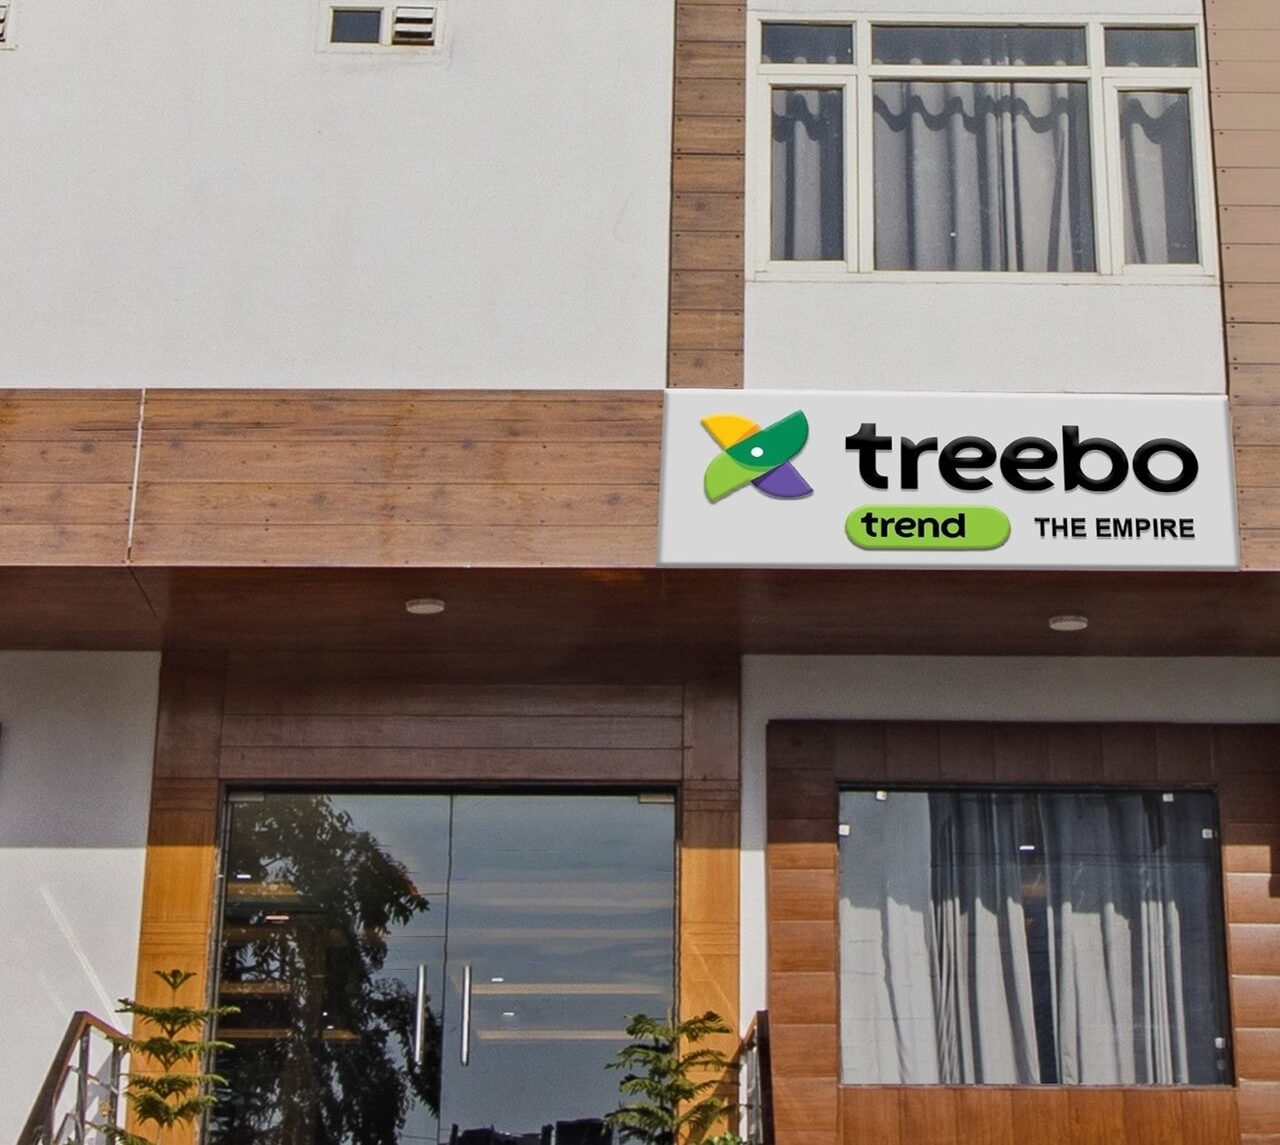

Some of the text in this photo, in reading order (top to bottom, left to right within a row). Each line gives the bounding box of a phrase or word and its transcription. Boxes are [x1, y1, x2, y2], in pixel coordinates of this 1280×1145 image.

[845, 422, 1199, 493] treebo
[860, 512, 966, 539] trend
[1034, 517, 1195, 540] THE EMPIRE
